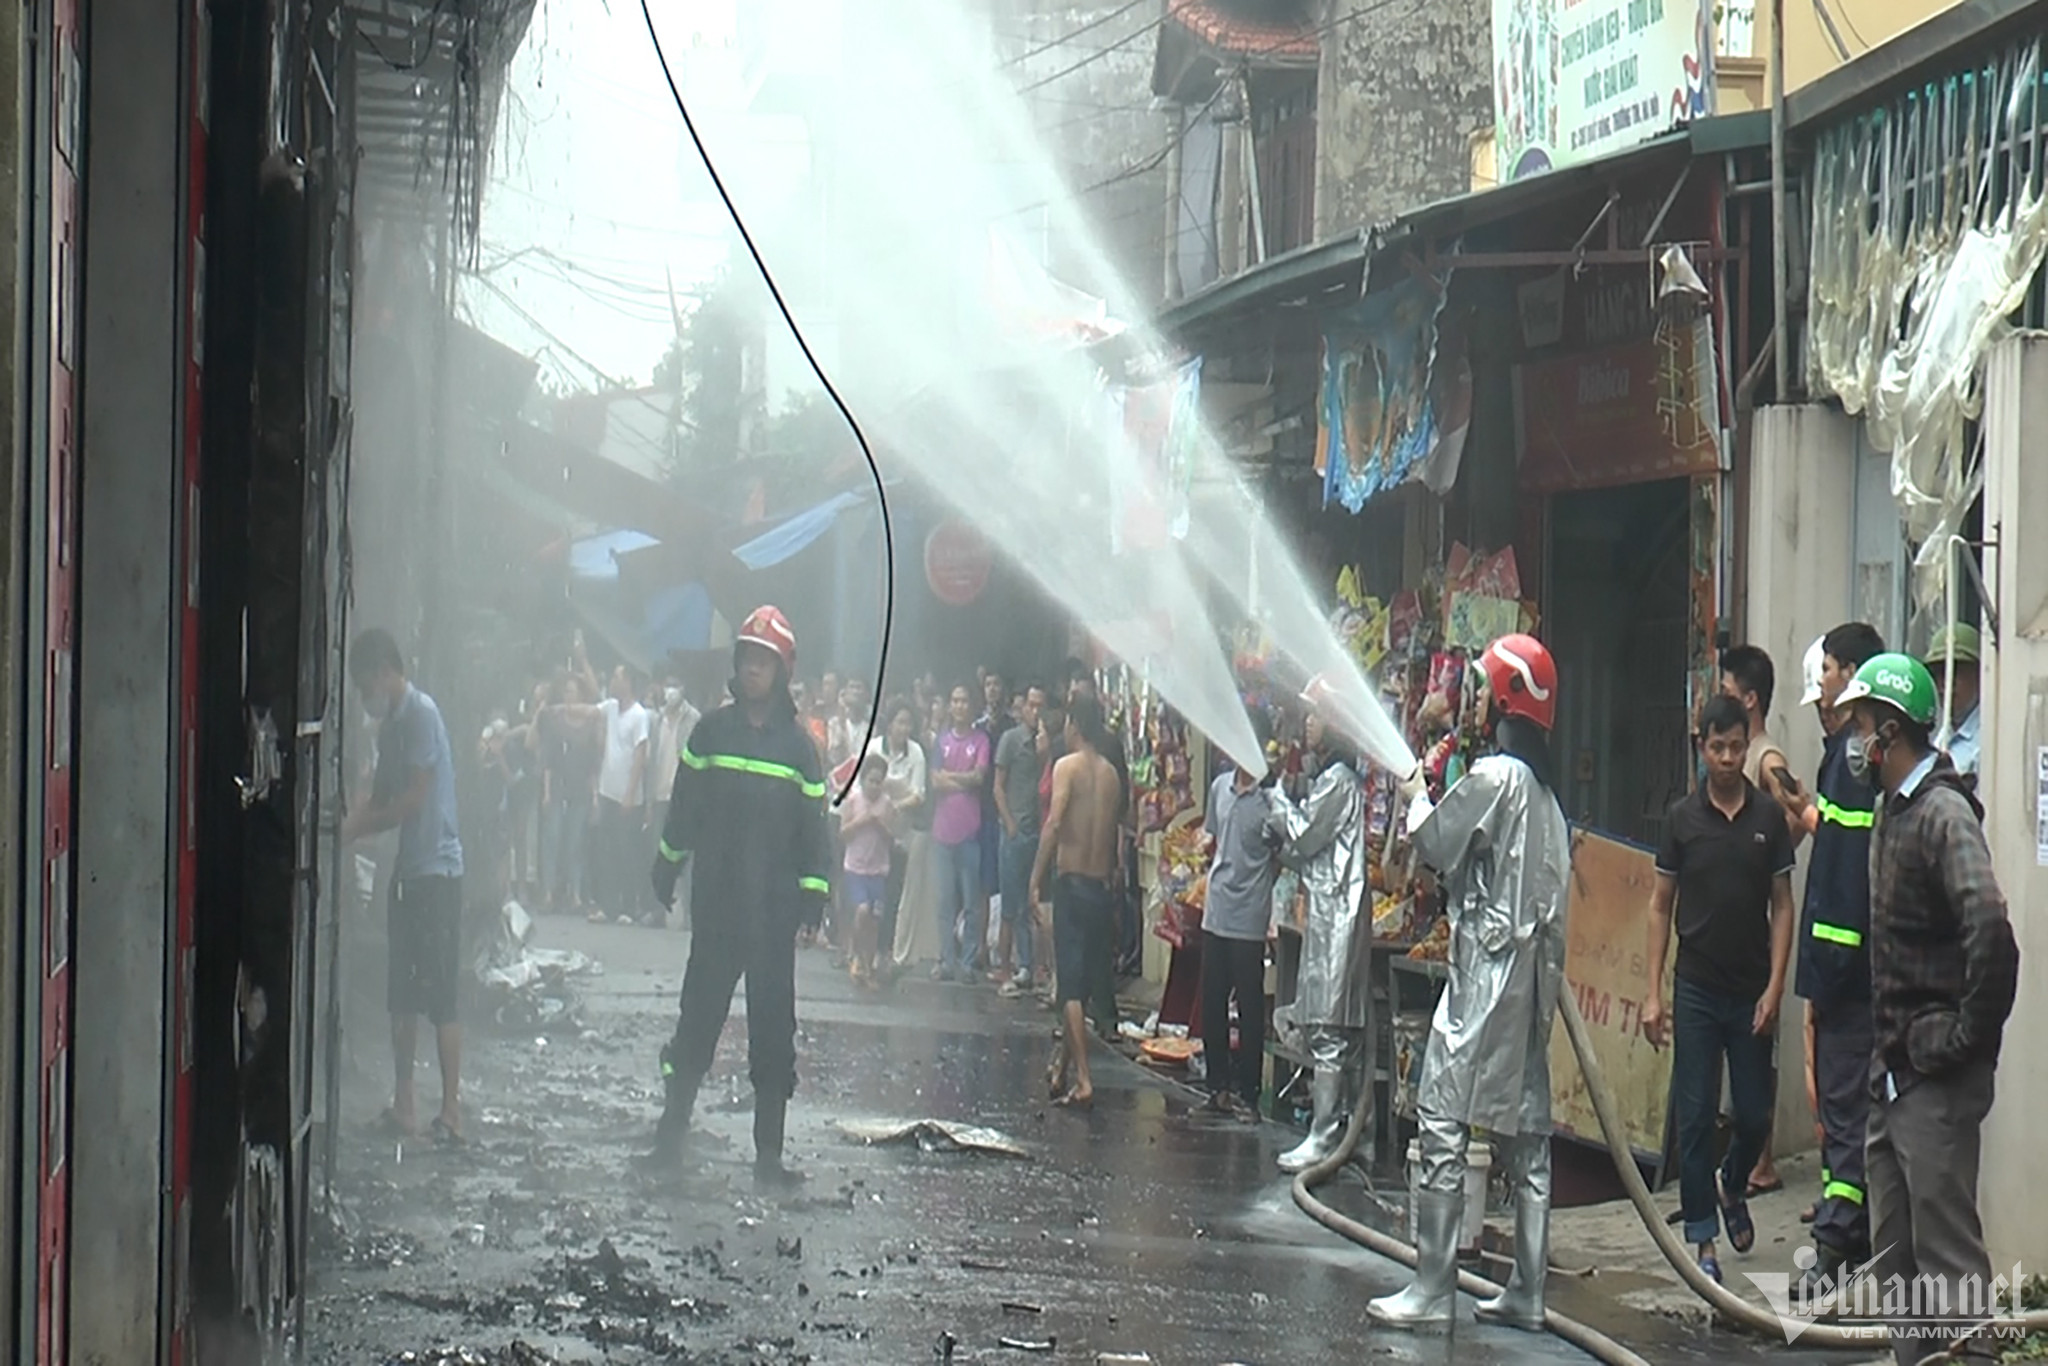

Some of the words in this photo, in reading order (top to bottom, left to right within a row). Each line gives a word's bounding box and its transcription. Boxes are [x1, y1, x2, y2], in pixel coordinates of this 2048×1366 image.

[1583, 65, 1602, 109] NƯỚC
[1619, 48, 1639, 92] KHÁT
[1876, 669, 1914, 694] Grab
[1569, 979, 1612, 1027] IM
